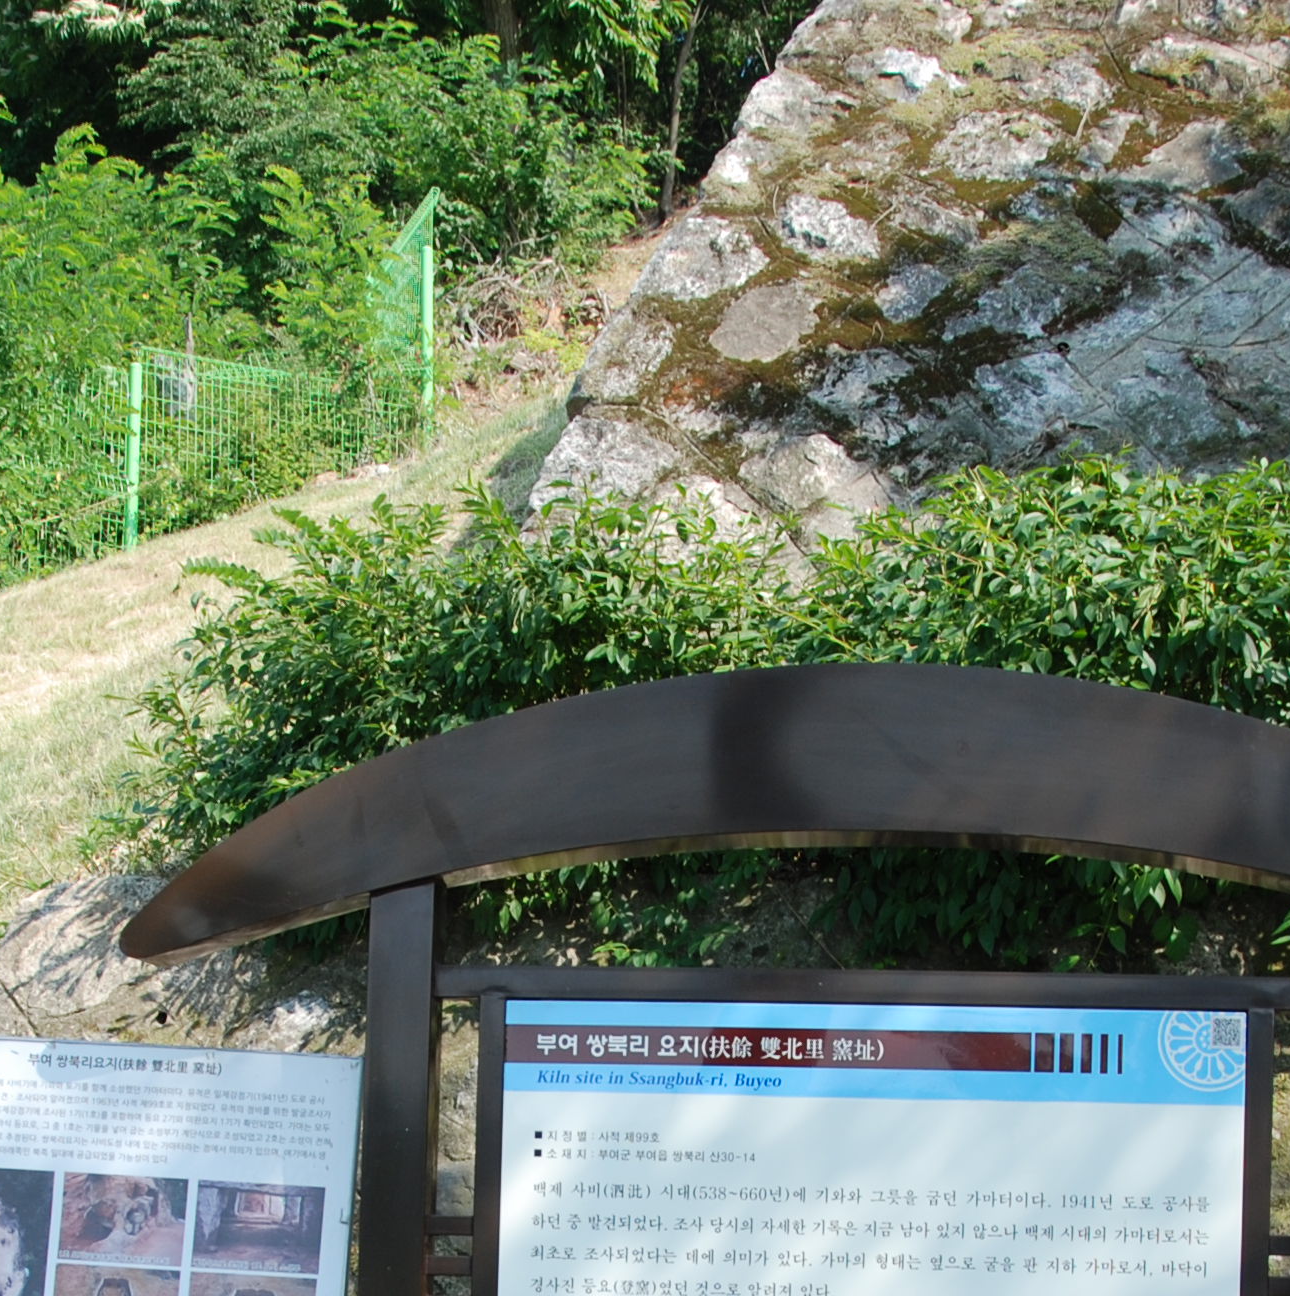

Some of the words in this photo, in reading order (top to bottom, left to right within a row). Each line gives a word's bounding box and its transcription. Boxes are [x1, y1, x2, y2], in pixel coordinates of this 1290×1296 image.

[536, 1033, 577, 1055] 부여
[585, 1034, 649, 1058] 쌍북리
[760, 1036, 824, 1060] 雙北里
[151, 1058, 188, 1074] 雙北里
[537, 1069, 570, 1084] Kiln
[574, 1070, 603, 1084] site
[608, 1071, 624, 1085] in
[628, 1070, 728, 1091] Ssangbuk-ri,
[733, 1072, 782, 1092] Buyeo
[597, 1130, 620, 1143] 사적
[624, 1130, 660, 1144] 제99호
[597, 1148, 631, 1161] 부여군
[634, 1148, 668, 1162] 부여읍
[672, 1149, 705, 1163] 쌍북리
[708, 1150, 756, 1164] 산30-14
[532, 1180, 562, 1198] 백제
[815, 1185, 862, 1205] 기와와
[870, 1188, 918, 1206] 그릇을
[925, 1188, 957, 1207] 굽던
[966, 1189, 1052, 1209] 가마터이다.
[1061, 1192, 1113, 1211] 1941년
[1121, 1195, 1154, 1210] 도로
[1161, 1194, 1210, 1213] 공사를
[531, 1212, 561, 1230] 하던
[566, 1213, 582, 1231] 중
[587, 1213, 668, 1232] 발견되었다.
[672, 1215, 704, 1233] 조사
[709, 1215, 754, 1235] 당시의
[760, 1216, 806, 1236] 자세한
[812, 1218, 858, 1237] 기록은
[862, 1219, 894, 1238] 지금
[899, 1220, 930, 1239] 남아
[935, 1221, 965, 1240] 있지
[972, 1222, 1019, 1241] 않으나
[1024, 1223, 1054, 1242] 백제
[1060, 1224, 1106, 1243] 시대의
[1114, 1225, 1209, 1246] 가마터로서는
[529, 1243, 577, 1262] 최초로
[583, 1245, 677, 1265] 조사되었다는
[685, 1247, 714, 1265] 데에
[722, 1248, 769, 1267] 의미가
[777, 1249, 813, 1268] 있다.
[820, 1250, 866, 1270] 가마의
[875, 1252, 922, 1271] 형태는
[929, 1253, 976, 1272] 옆으로
[982, 1255, 1015, 1273] 굴을
[1022, 1255, 1038, 1274] 판
[1045, 1256, 1077, 1275] 지하
[1161, 1259, 1207, 1278] 바닥이
[530, 1275, 575, 1294] 경사진
